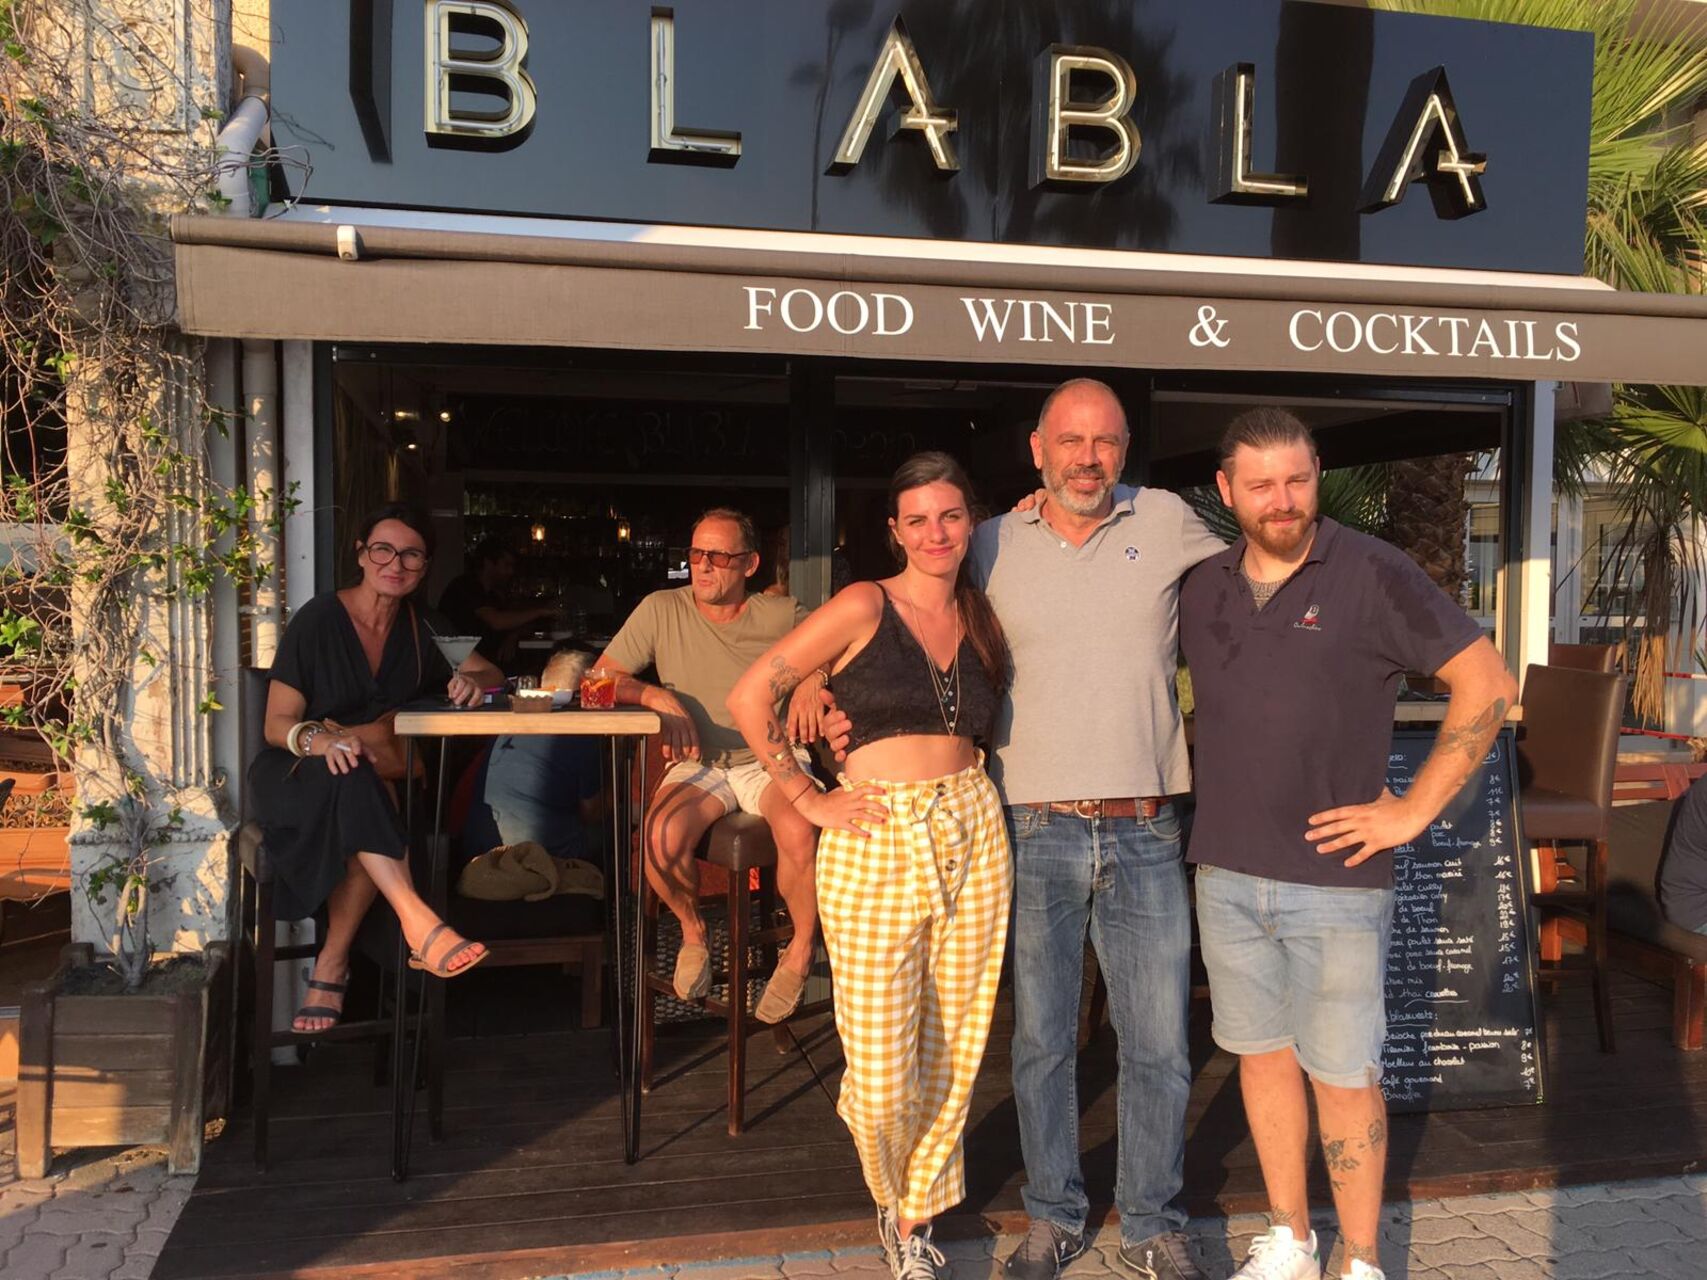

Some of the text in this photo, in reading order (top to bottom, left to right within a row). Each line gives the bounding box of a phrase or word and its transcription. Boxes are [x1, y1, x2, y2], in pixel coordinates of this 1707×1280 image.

[424, 0, 1489, 220] BLABLA
[742, 286, 1582, 363] FOOD WINE & COCKTAILS
